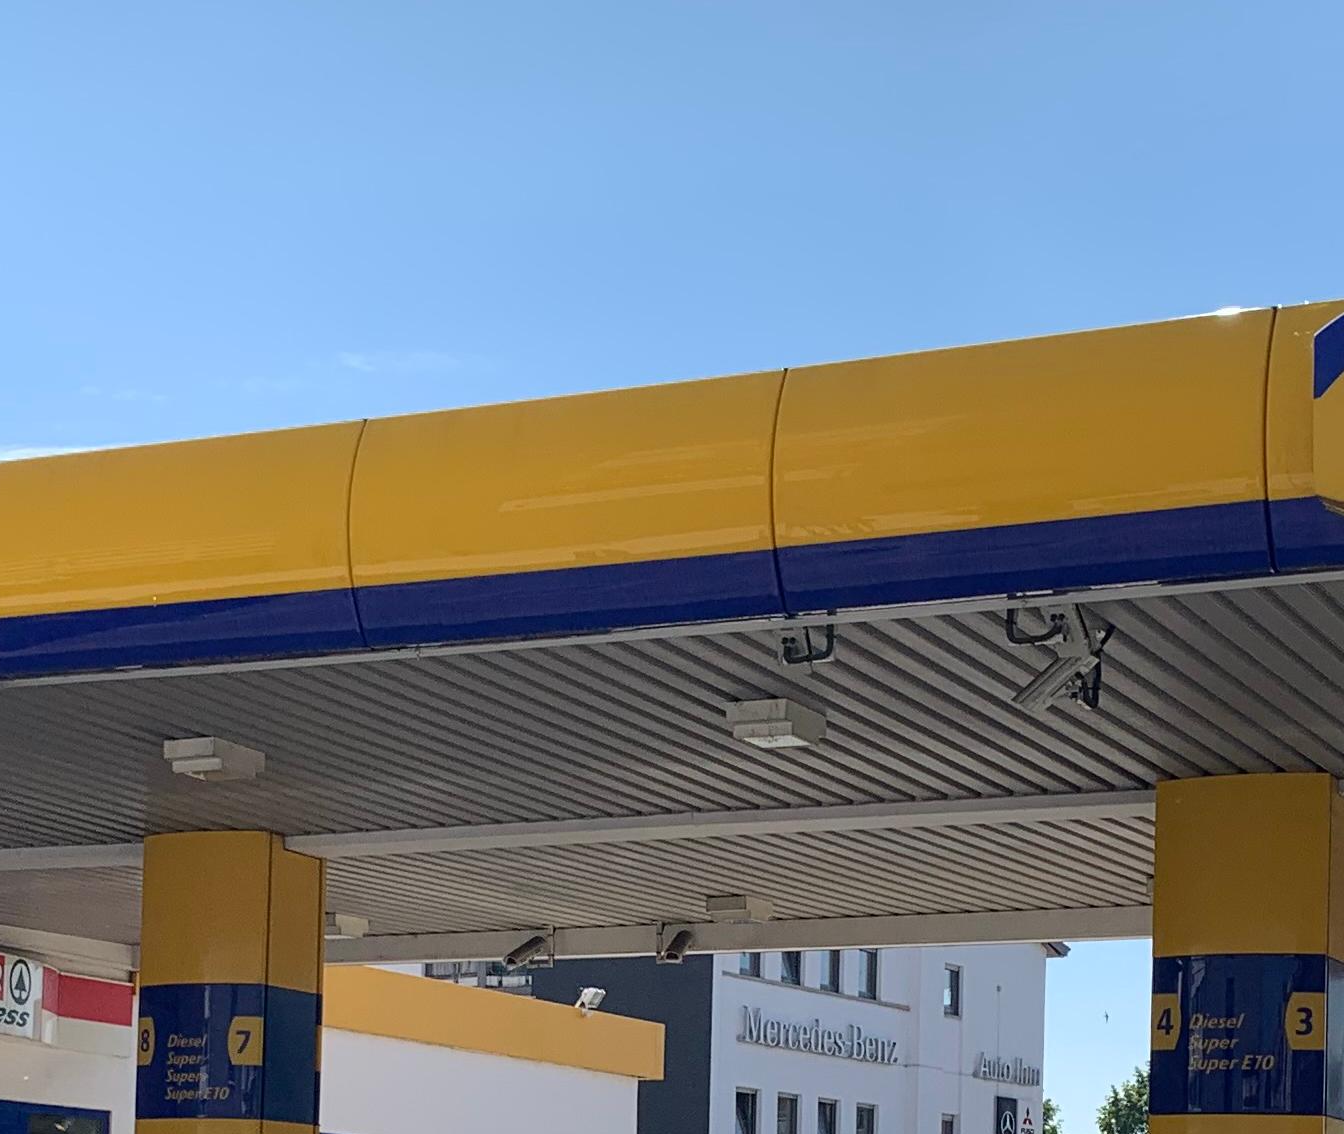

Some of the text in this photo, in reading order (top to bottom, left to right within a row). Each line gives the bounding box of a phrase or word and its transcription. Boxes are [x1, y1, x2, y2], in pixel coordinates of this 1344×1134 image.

[1157, 1008, 1174, 1036] 4
[1189, 1013, 1245, 1029] Diesel
[1295, 1007, 1313, 1036] 3
[140, 1029, 150, 1052] 8
[167, 1033, 207, 1048] Diesel
[236, 1030, 251, 1054] 7
[742, 1005, 898, 1064] Mercedes-Benz
[1188, 1035, 1239, 1055] Super
[167, 1051, 202, 1069] Super
[979, 1055, 1012, 1081] Auto
[1188, 1054, 1275, 1074] Super E10
